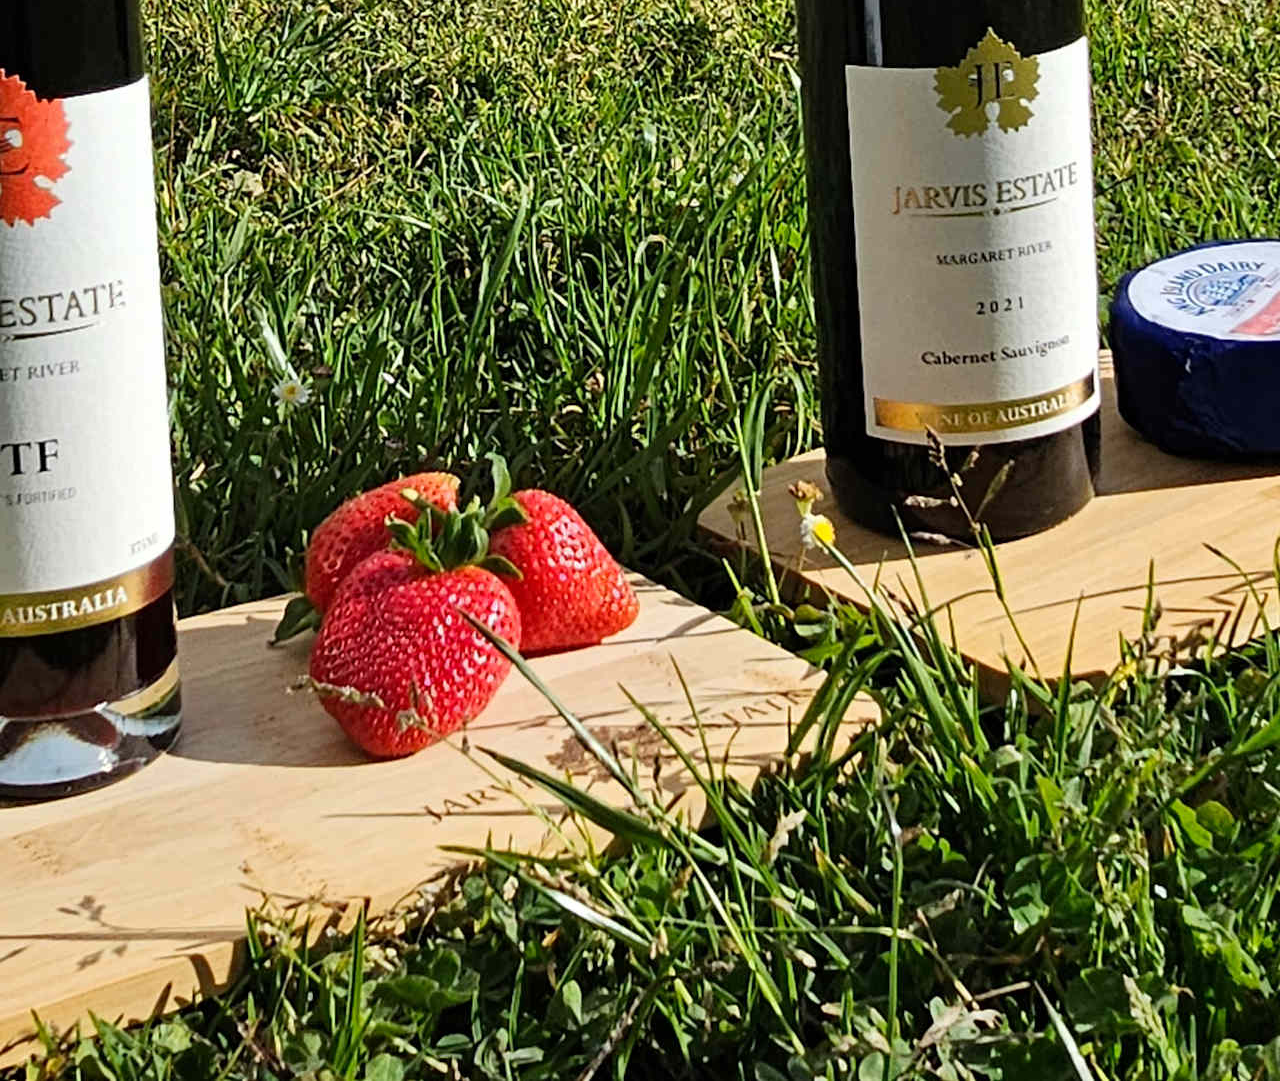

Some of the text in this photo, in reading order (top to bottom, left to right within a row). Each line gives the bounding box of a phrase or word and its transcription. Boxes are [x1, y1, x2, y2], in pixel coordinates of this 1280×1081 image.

[893, 162, 1078, 215] JARVIS ESTATE
[936, 239, 1053, 266] MARGARET RIVER
[1197, 261, 1265, 275] DAIRY
[975, 296, 1025, 316] 2021
[920, 334, 1070, 366] Cabernet Sauvignon
[27, 359, 81, 381] RIVER
[969, 409, 995, 425] OF
[3, 585, 129, 625] AUSTRALIA
